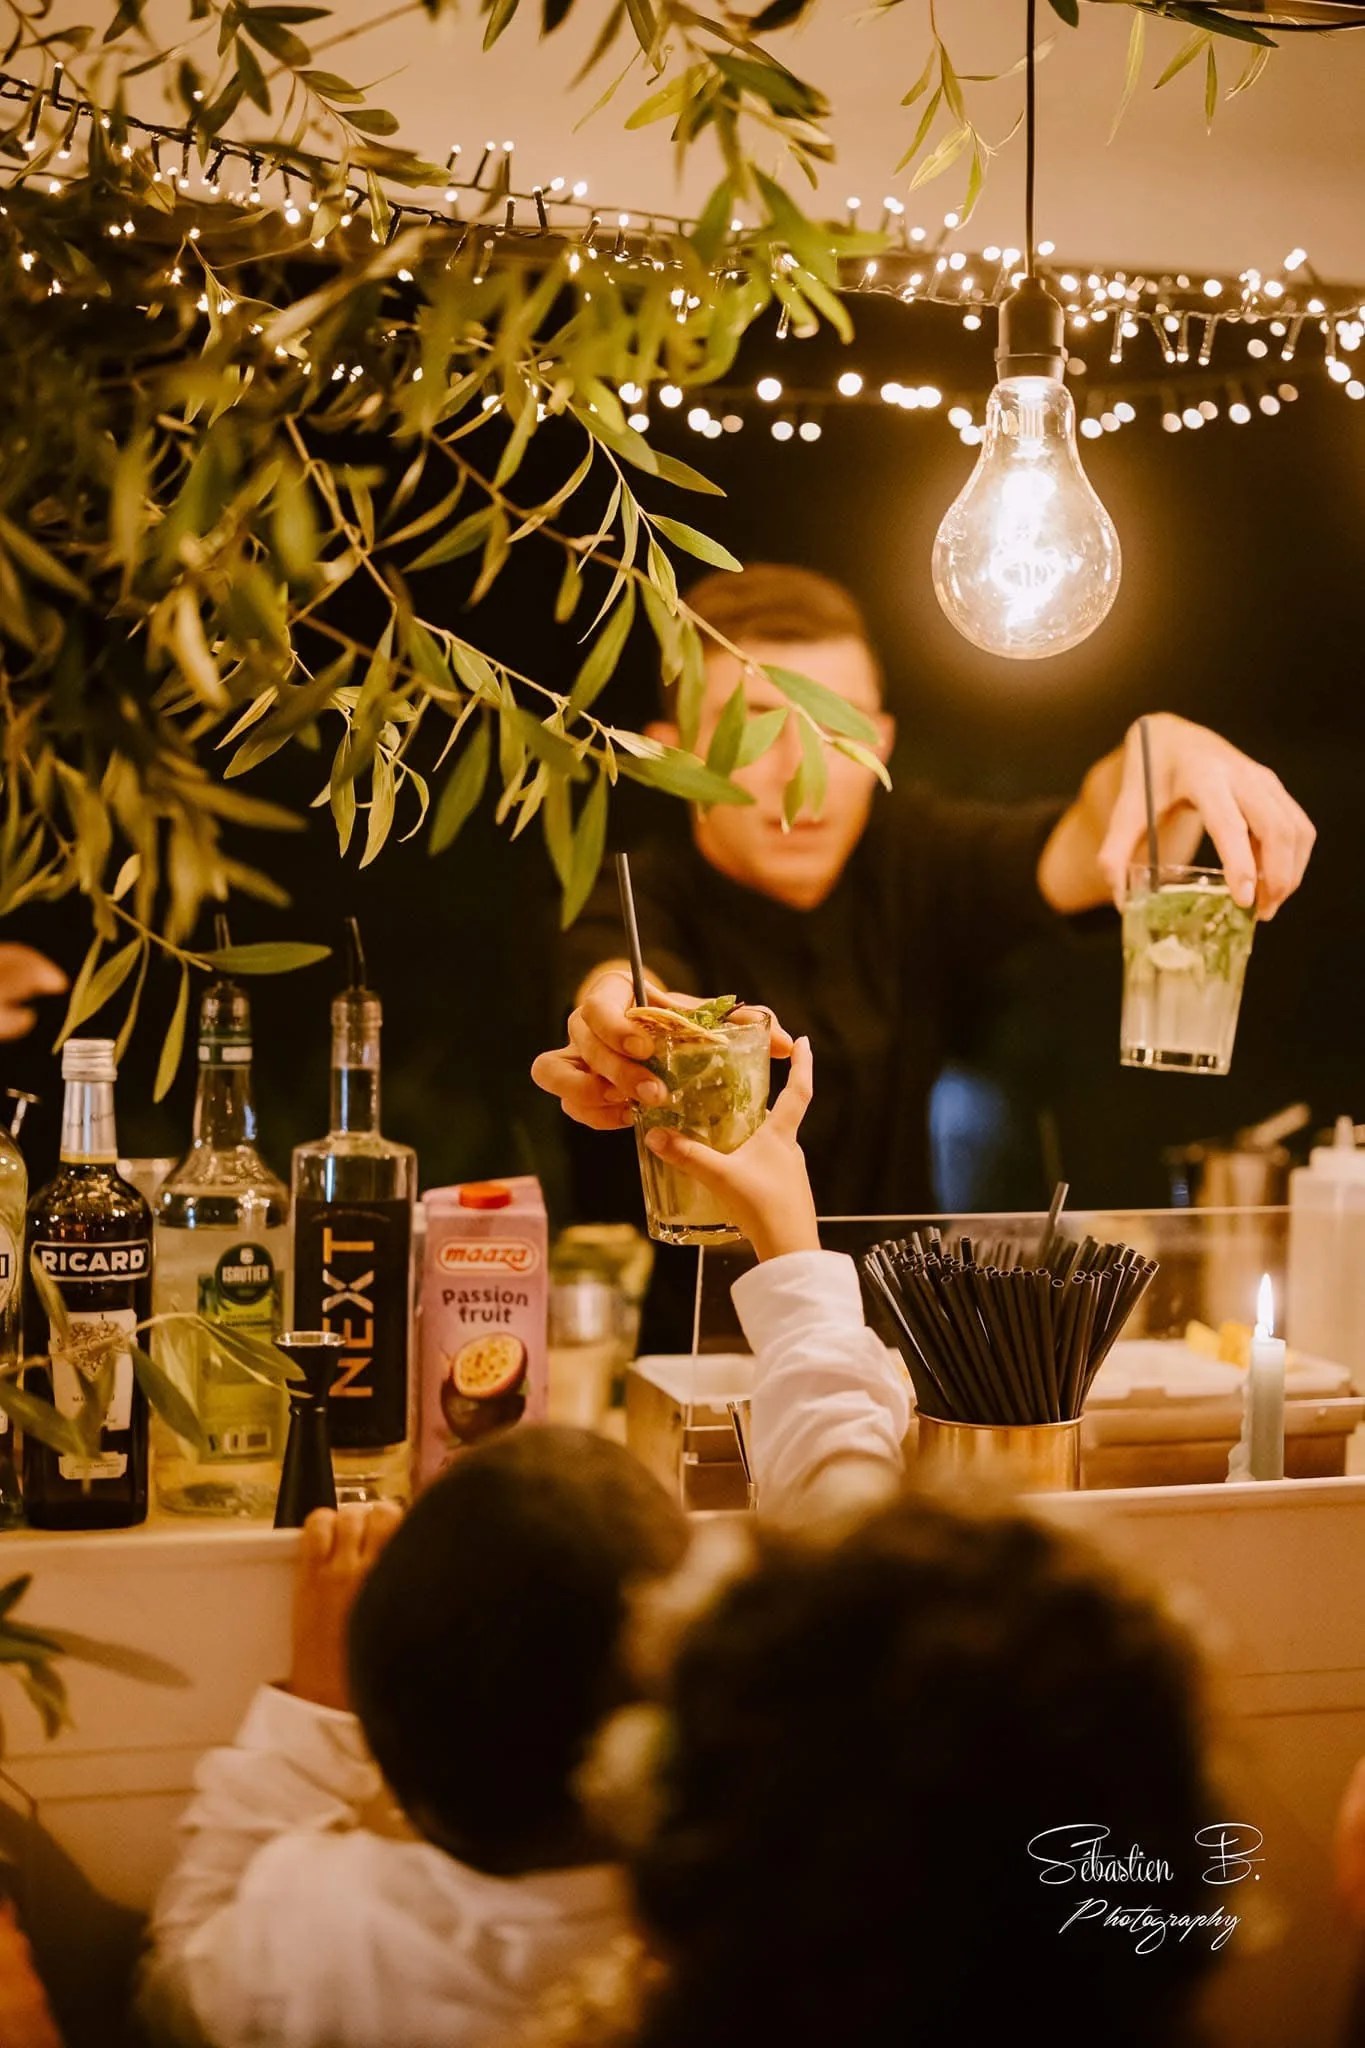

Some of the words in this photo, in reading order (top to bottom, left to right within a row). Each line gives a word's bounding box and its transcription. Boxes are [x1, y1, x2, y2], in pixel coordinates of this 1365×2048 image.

[41, 1249, 144, 1272] RICARD
[444, 1247, 529, 1271] maaza
[322, 1227, 375, 1397] NEXT
[458, 1306, 513, 1324] fruit
